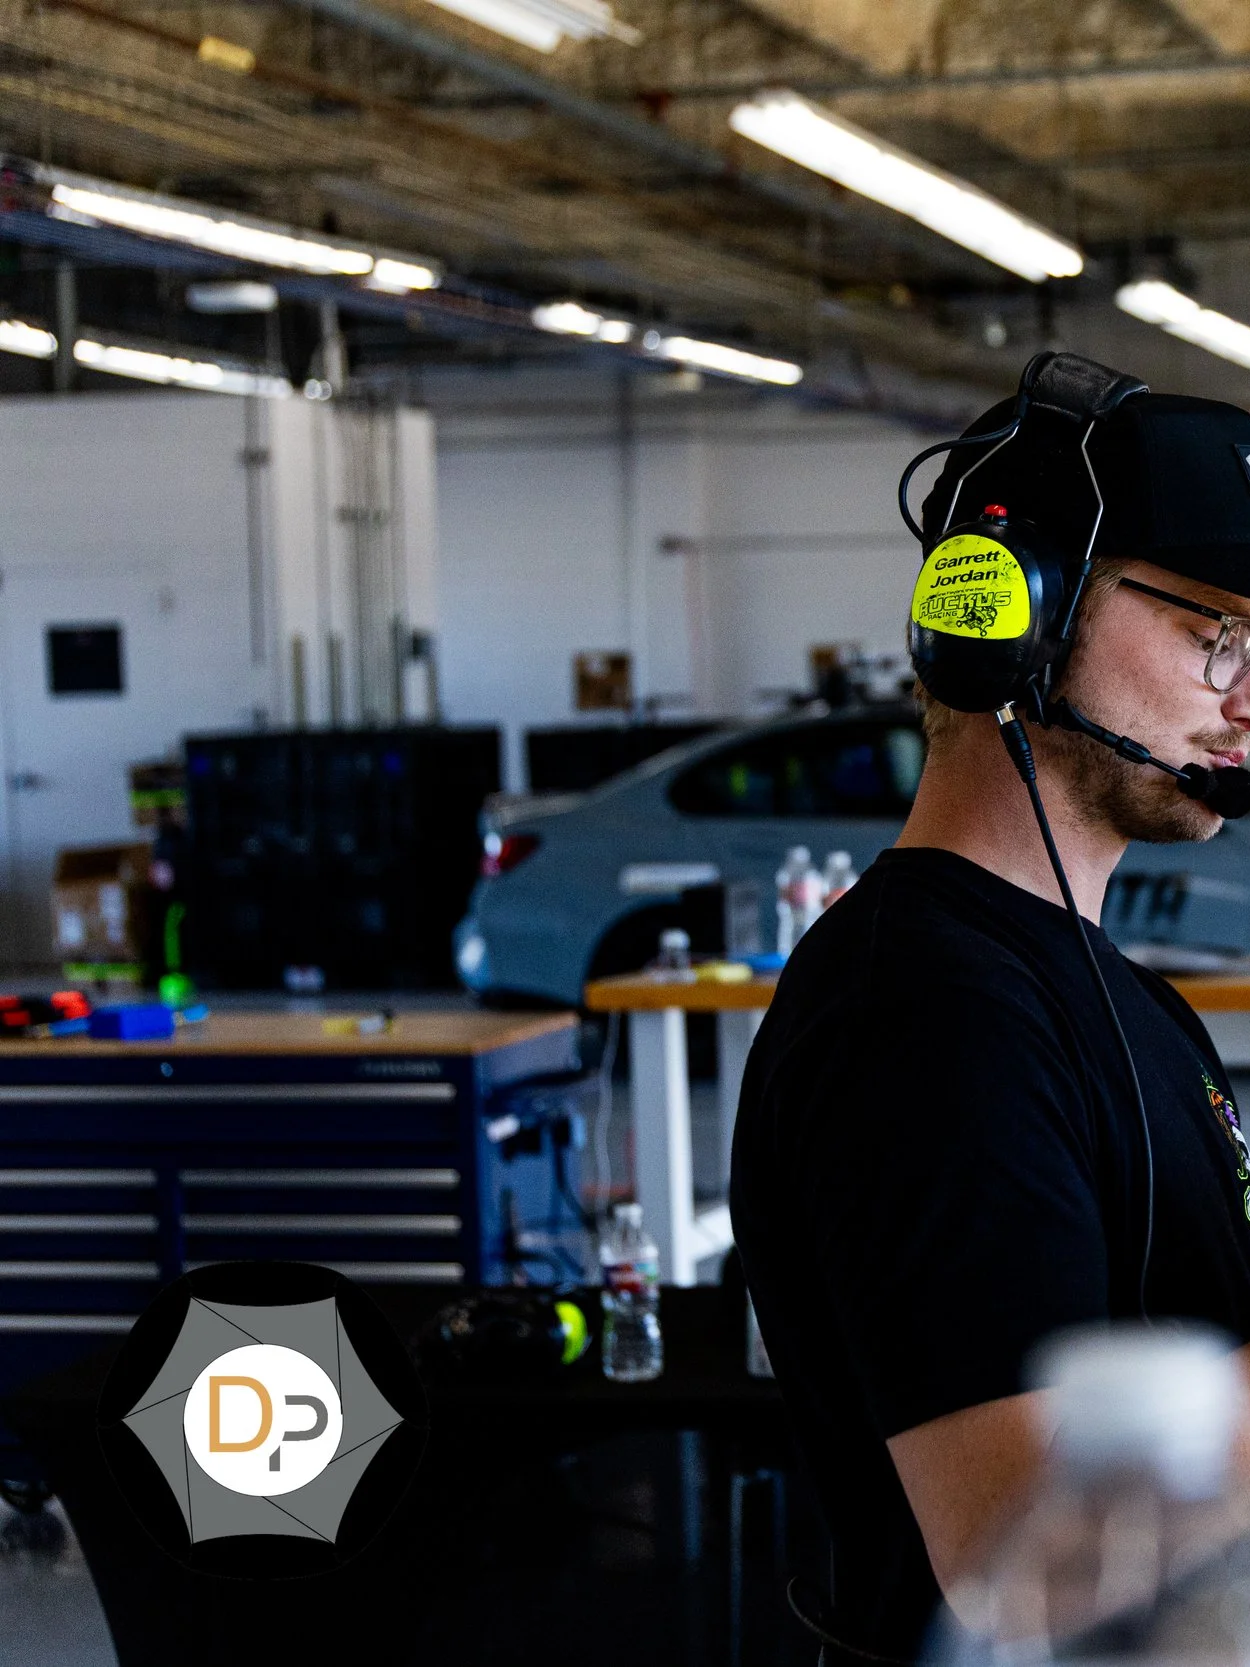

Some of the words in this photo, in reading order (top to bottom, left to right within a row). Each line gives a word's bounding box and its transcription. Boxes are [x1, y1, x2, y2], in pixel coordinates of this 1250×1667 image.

[934, 551, 1001, 571] Garrett
[930, 570, 998, 589] Jordan
[918, 590, 1012, 620] RUCKUS
[927, 610, 958, 621] RACING
